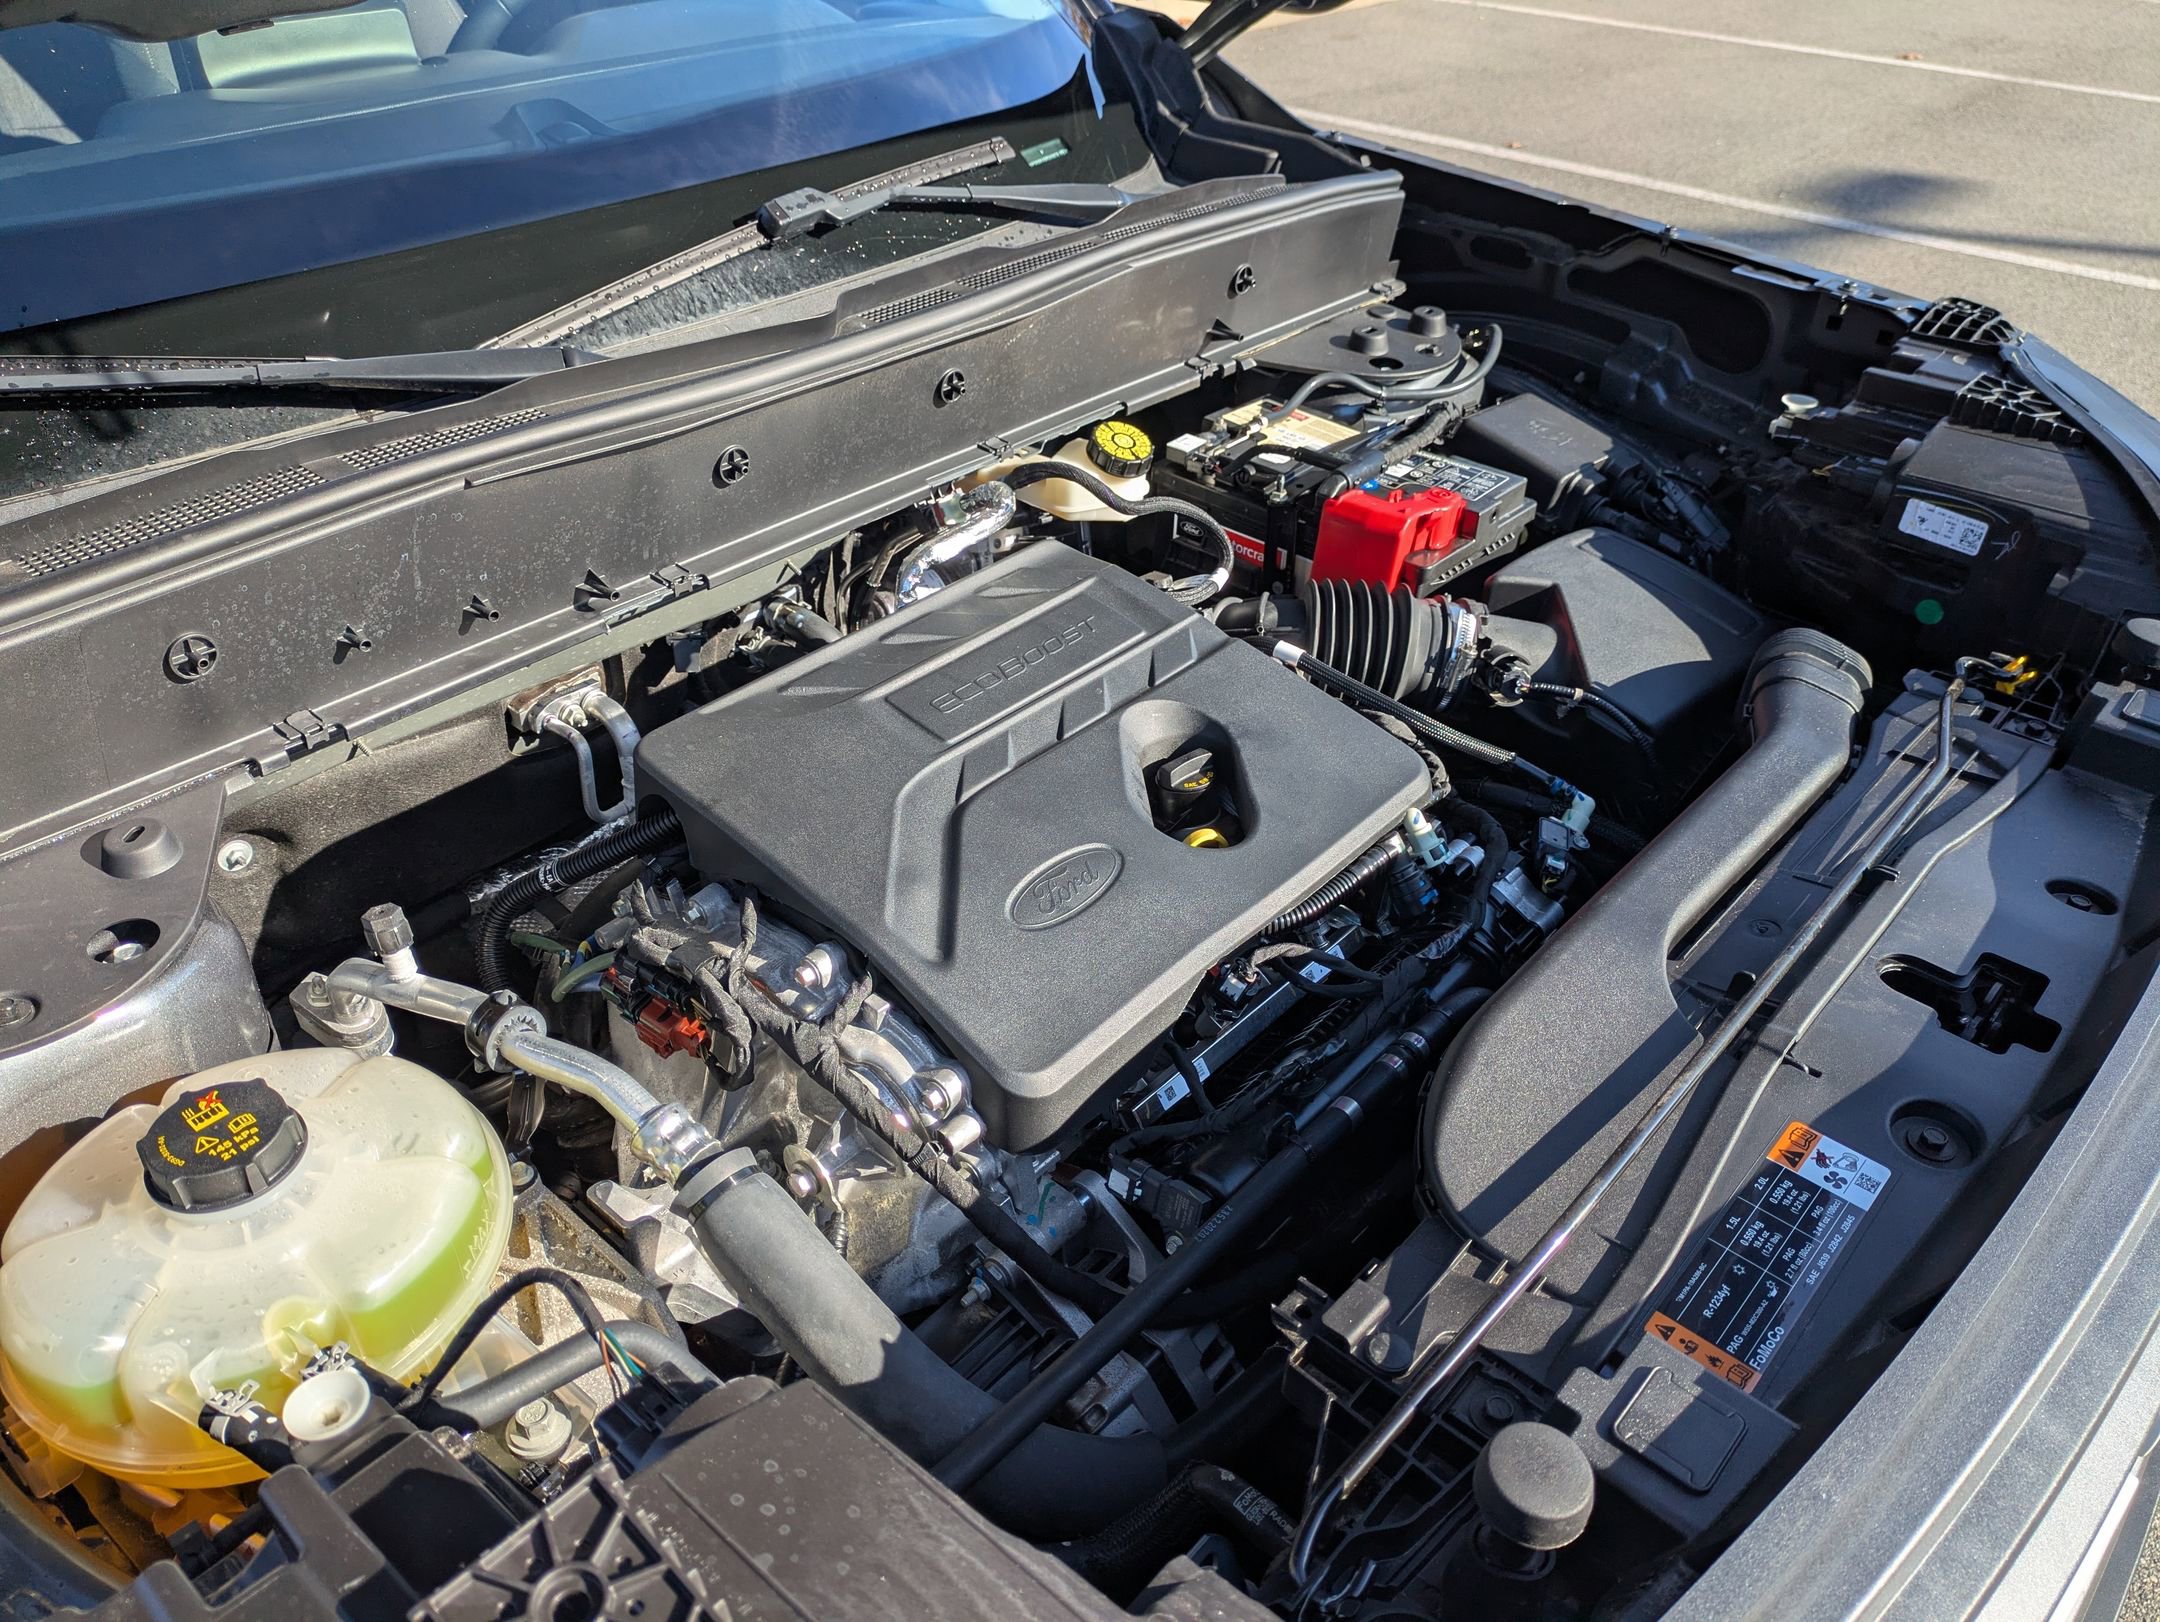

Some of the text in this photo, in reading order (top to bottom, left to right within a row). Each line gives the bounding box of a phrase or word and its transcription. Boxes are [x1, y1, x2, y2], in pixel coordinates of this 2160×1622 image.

[1231, 540, 1264, 562] torcra
[929, 615, 1096, 714] ECOBOOST
[1032, 860, 1100, 915] Ford
[208, 1126, 260, 1157] 145 kPa
[220, 1135, 260, 1162] 21 psi
[1754, 1177, 1769, 1190] 2.0L
[1769, 1187, 1785, 1204] 0.550
[1726, 1216, 1741, 1229] 1.5L
[1811, 1205, 1824, 1218] PAG
[1740, 1228, 1756, 1246] 0.550
[1782, 1247, 1795, 1261] PAG
[1806, 1214, 1855, 1285] SAE J639 J2842 J2845
[1703, 1284, 1730, 1318] R-1234yf
[1726, 1335, 1743, 1354] PAG
[1750, 1325, 1785, 1371] FoMoCo
